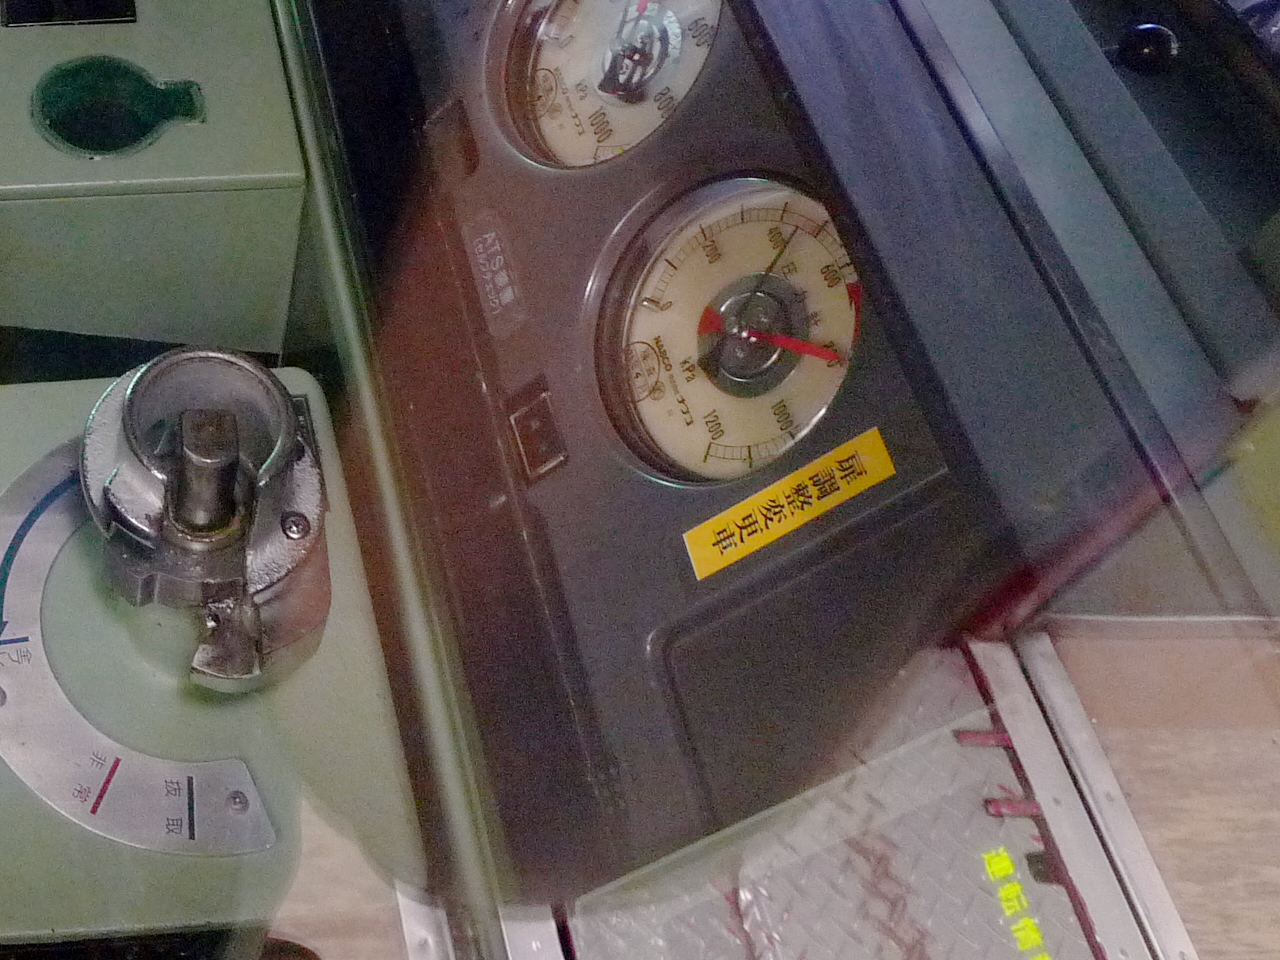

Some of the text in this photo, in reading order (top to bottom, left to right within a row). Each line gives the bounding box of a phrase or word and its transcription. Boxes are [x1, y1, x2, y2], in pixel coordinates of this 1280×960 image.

[587, 105, 614, 143] 1000
[701, 239, 722, 265] 200
[820, 263, 843, 289] 600
[653, 334, 674, 372] NABCO
[680, 355, 697, 383] kPa
[703, 408, 725, 441] 1200
[771, 398, 795, 432] 1000
[711, 449, 868, 557] 扉調整変更車
[71, 750, 108, 804] 非常
[163, 778, 184, 836] 抜取
